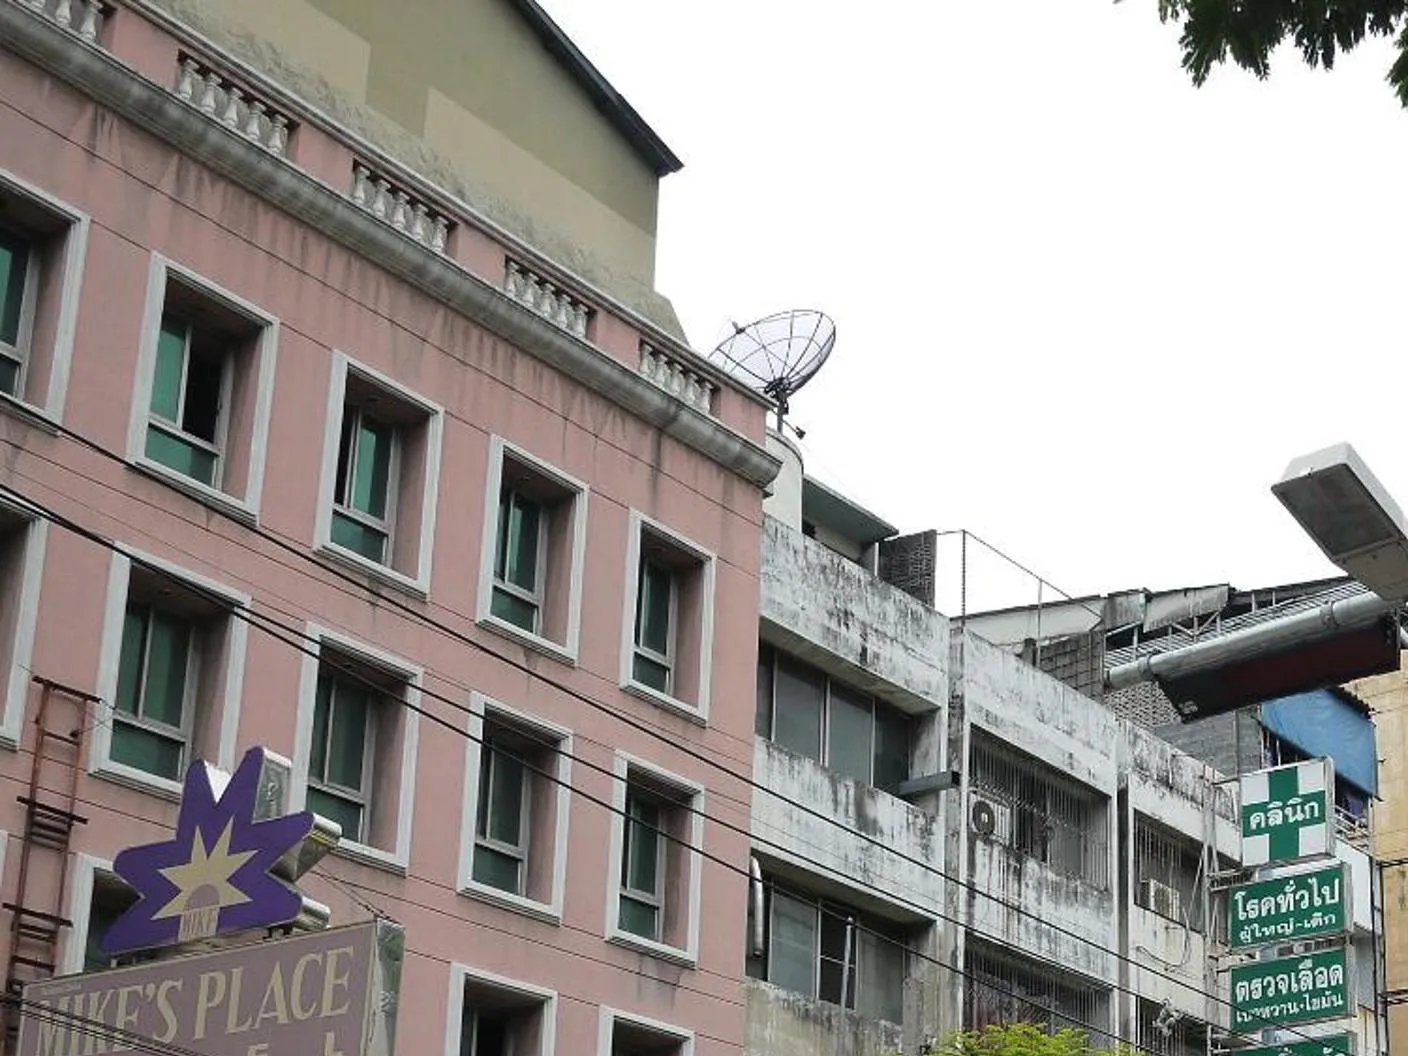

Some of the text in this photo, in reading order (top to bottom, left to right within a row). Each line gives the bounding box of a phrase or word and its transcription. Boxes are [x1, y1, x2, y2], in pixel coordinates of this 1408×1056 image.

[1250, 797, 1319, 830] คลินิก
[1234, 878, 1340, 921] โรคทั่วไป
[193, 946, 355, 1040] PLACE
[1235, 959, 1343, 1003] ตรวจเลือด
